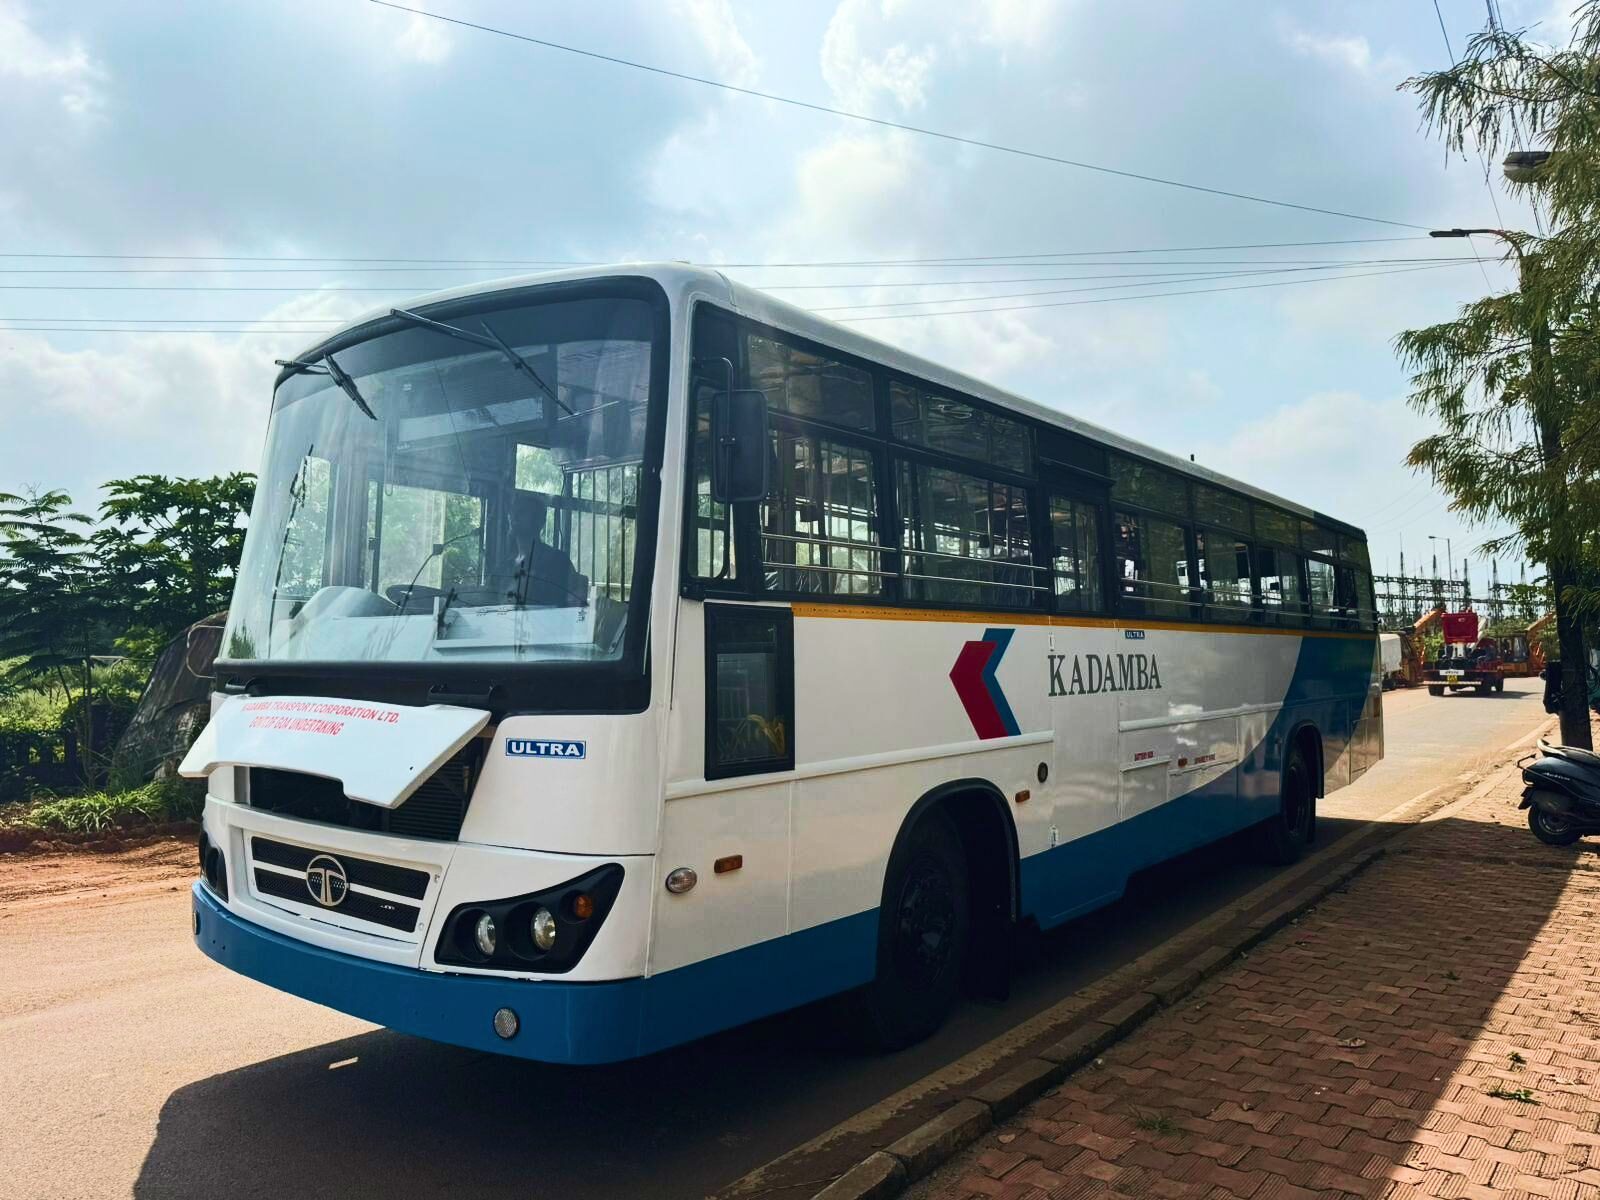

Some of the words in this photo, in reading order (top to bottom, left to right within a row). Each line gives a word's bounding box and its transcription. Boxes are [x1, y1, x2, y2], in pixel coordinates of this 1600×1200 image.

[1047, 654, 1162, 697] KADAMBA
[314, 703, 380, 720] CORPORATION
[287, 718, 345, 736] UNDERTAKING
[511, 741, 580, 756] ULTRA
